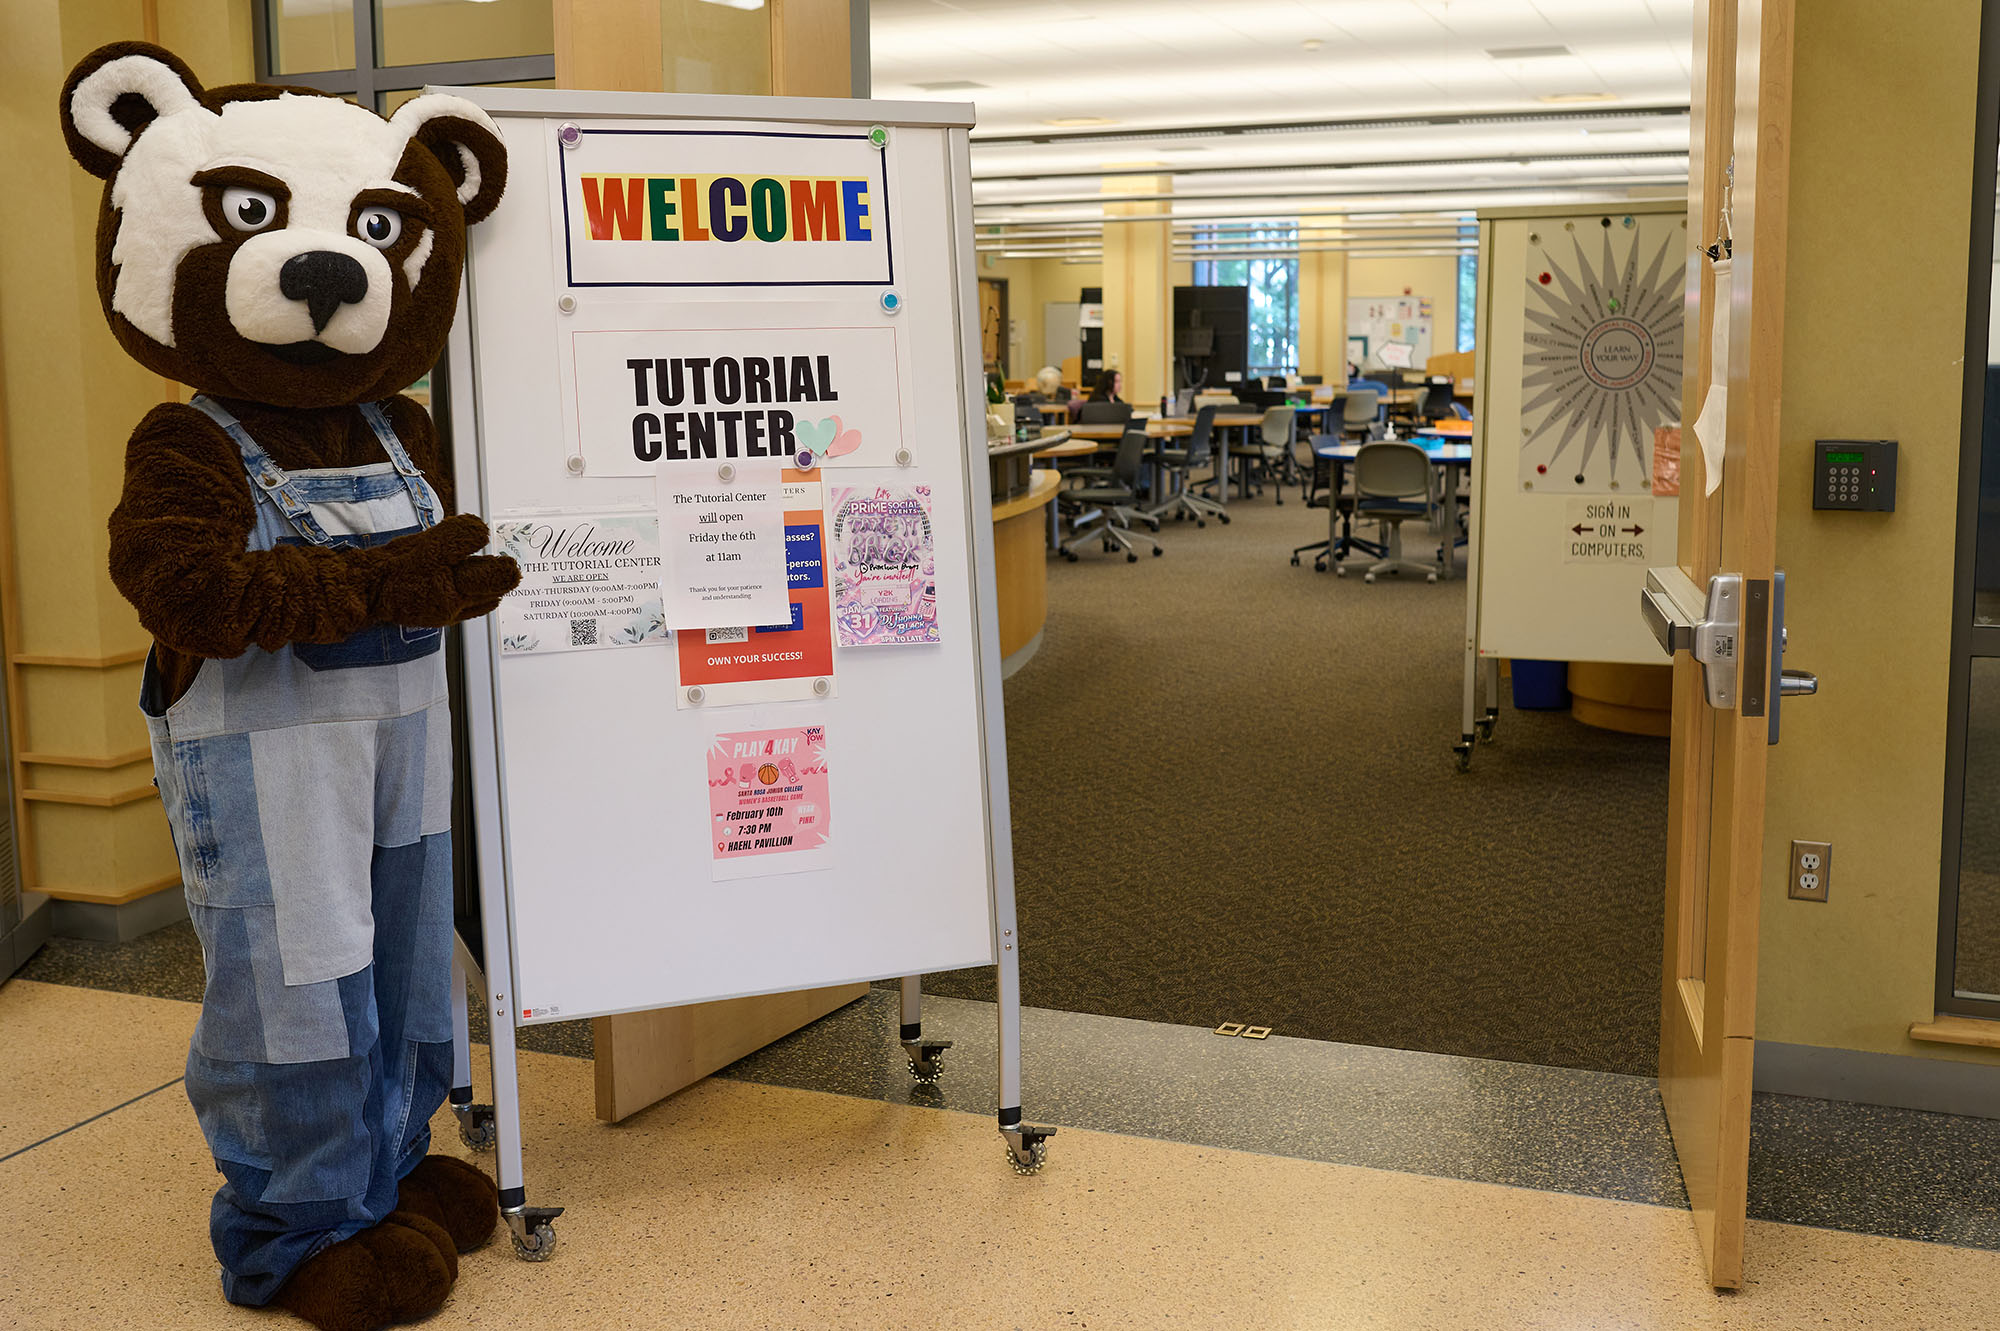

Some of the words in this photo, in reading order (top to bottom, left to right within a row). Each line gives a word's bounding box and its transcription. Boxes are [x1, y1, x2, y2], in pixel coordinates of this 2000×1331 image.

[580, 177, 873, 243] WELCOME
[626, 355, 839, 407] TUTORIAL
[632, 410, 796, 462] CENTER
[673, 494, 692, 504] The
[694, 492, 733, 503] Tutorial
[735, 492, 766, 502] Center
[699, 512, 718, 524] will
[720, 513, 744, 524] open
[1586, 504, 1614, 519] SIGN
[1618, 505, 1630, 519] IN
[1600, 524, 1616, 537] ON
[529, 523, 634, 559] Welcome
[689, 532, 720, 544] Friday
[722, 532, 738, 541] the
[740, 531, 756, 540] 6th
[706, 554, 716, 562] at
[718, 552, 742, 561] 11am
[524, 562, 549, 572] THE
[551, 559, 612, 571] TUTORIAL
[614, 556, 661, 568] CENTER
[552, 575, 565, 583] WE
[568, 574, 584, 582] ARE
[586, 573, 609, 582] OPEN
[854, 570, 881, 586] You're
[592, 582, 658, 593] (9:00AM-7:00PM)
[530, 600, 560, 608] FRIDAY
[562, 598, 594, 606] (9:00AM
[602, 595, 634, 604] 5:00PM)
[524, 611, 568, 620] SATURDAY
[844, 606, 861, 614] JAN
[896, 620, 926, 634] BLACK
[708, 657, 731, 666] OWN
[733, 654, 760, 664] YOUR
[762, 651, 803, 662] SUCCESS!
[734, 738, 798, 758] PLAY4KAY
[726, 810, 764, 821] February
[766, 806, 783, 817] 10th
[799, 816, 815, 824] PINK!
[738, 824, 757, 836] 7:30
[759, 823, 772, 834] PM
[728, 840, 752, 852] HAEHL
[754, 836, 793, 849] PAVILLION
